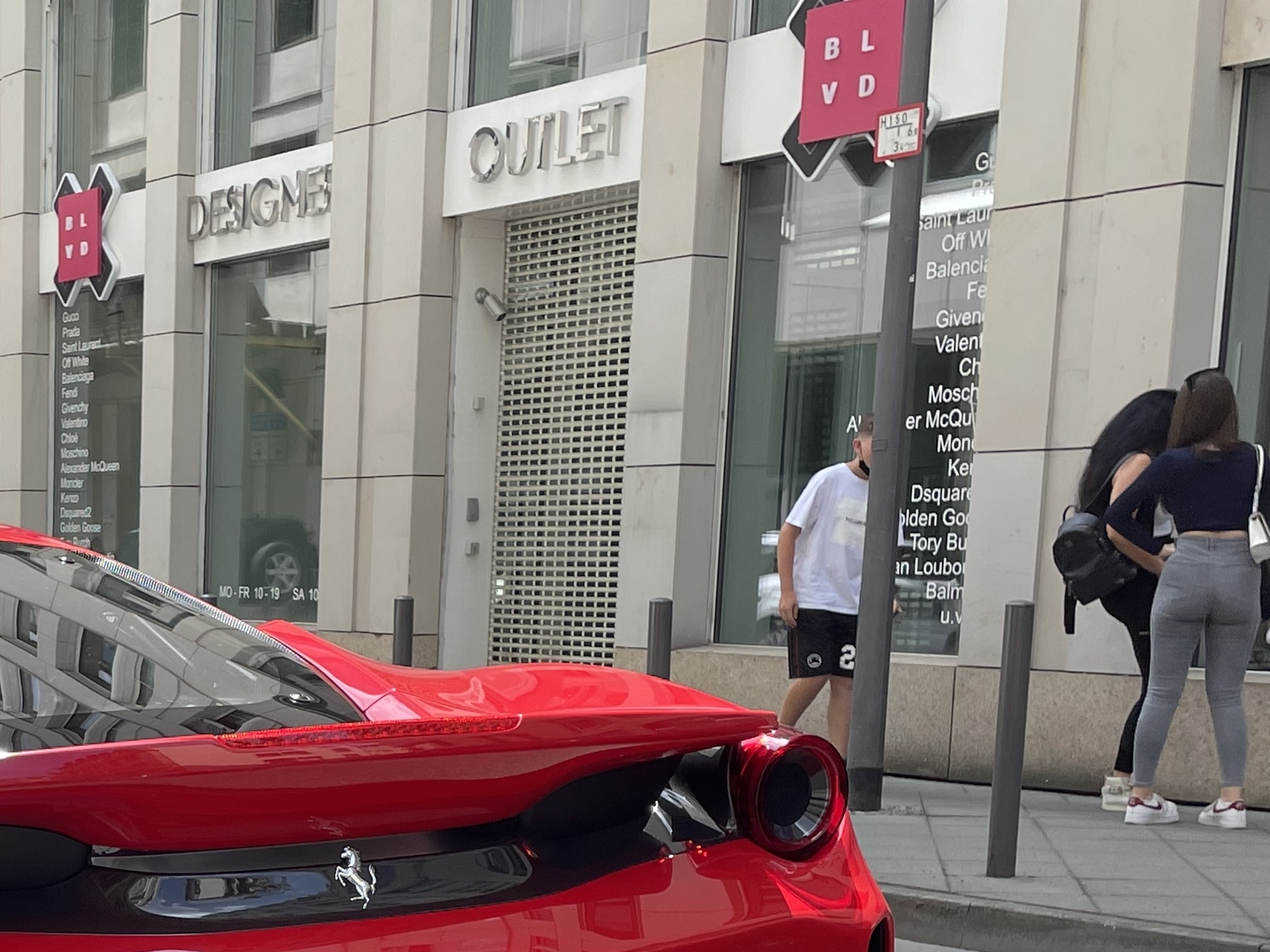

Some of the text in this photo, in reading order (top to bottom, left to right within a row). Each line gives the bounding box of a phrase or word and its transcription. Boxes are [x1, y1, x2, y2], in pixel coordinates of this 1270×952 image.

[468, 96, 629, 183] OUTLET
[941, 231, 966, 253] Off
[966, 281, 987, 300] Fe
[62, 311, 79, 324] Gucci
[935, 309, 985, 329] Given
[62, 326, 80, 338] Prada
[62, 342, 78, 354] Saint
[62, 356, 89, 369] Off White
[62, 370, 94, 384] Balenciaga
[62, 387, 78, 399] Fendi
[62, 402, 89, 415] Givenchy
[61, 417, 88, 429] Valentino
[60, 447, 89, 459] Moschino
[60, 461, 120, 474] Alexander McQueen
[60, 478, 84, 489] Moncler
[60, 493, 79, 504] Kenzo
[60, 506, 92, 520] Dsquared2
[60, 522, 101, 533] Golden Goose
[910, 532, 942, 556] Tory
[292, 588, 305, 601] SA
[309, 588, 319, 601] 10
